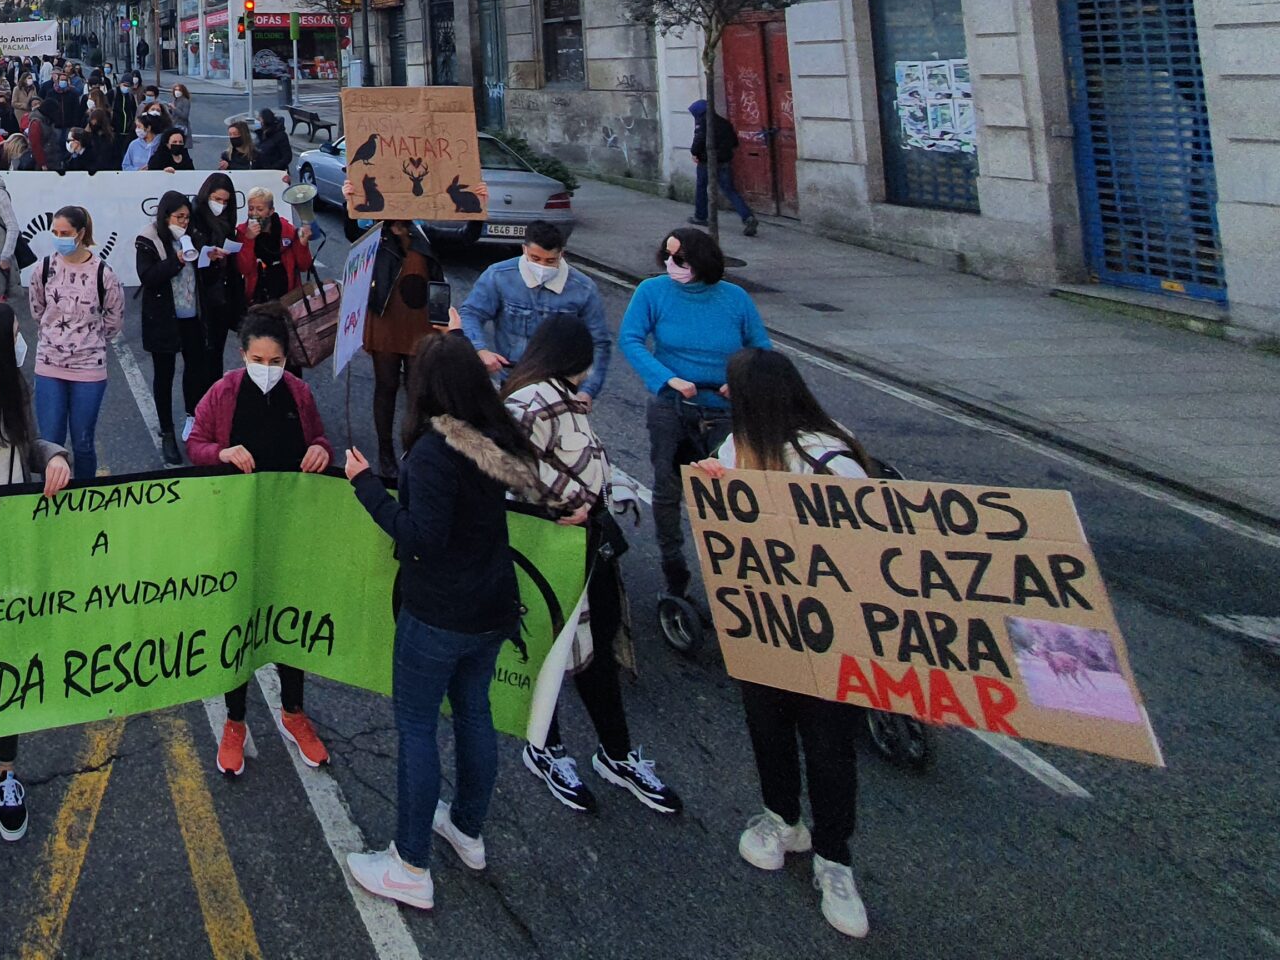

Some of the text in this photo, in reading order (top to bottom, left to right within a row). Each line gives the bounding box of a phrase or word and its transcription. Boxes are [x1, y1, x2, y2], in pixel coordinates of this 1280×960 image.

[10, 33, 52, 43] Animalista
[32, 480, 181, 521] AYUDANOS
[690, 476, 760, 524] NO
[91, 530, 109, 557] A
[84, 570, 238, 613] AYUDANDO
[702, 530, 1095, 611] PARA CAZAR
[64, 629, 208, 698] RESCUE
[220, 604, 336, 674] GALICIA
[860, 601, 1012, 678] PARA
[494, 667, 531, 690] LICIA
[835, 654, 1021, 738] AMAR
